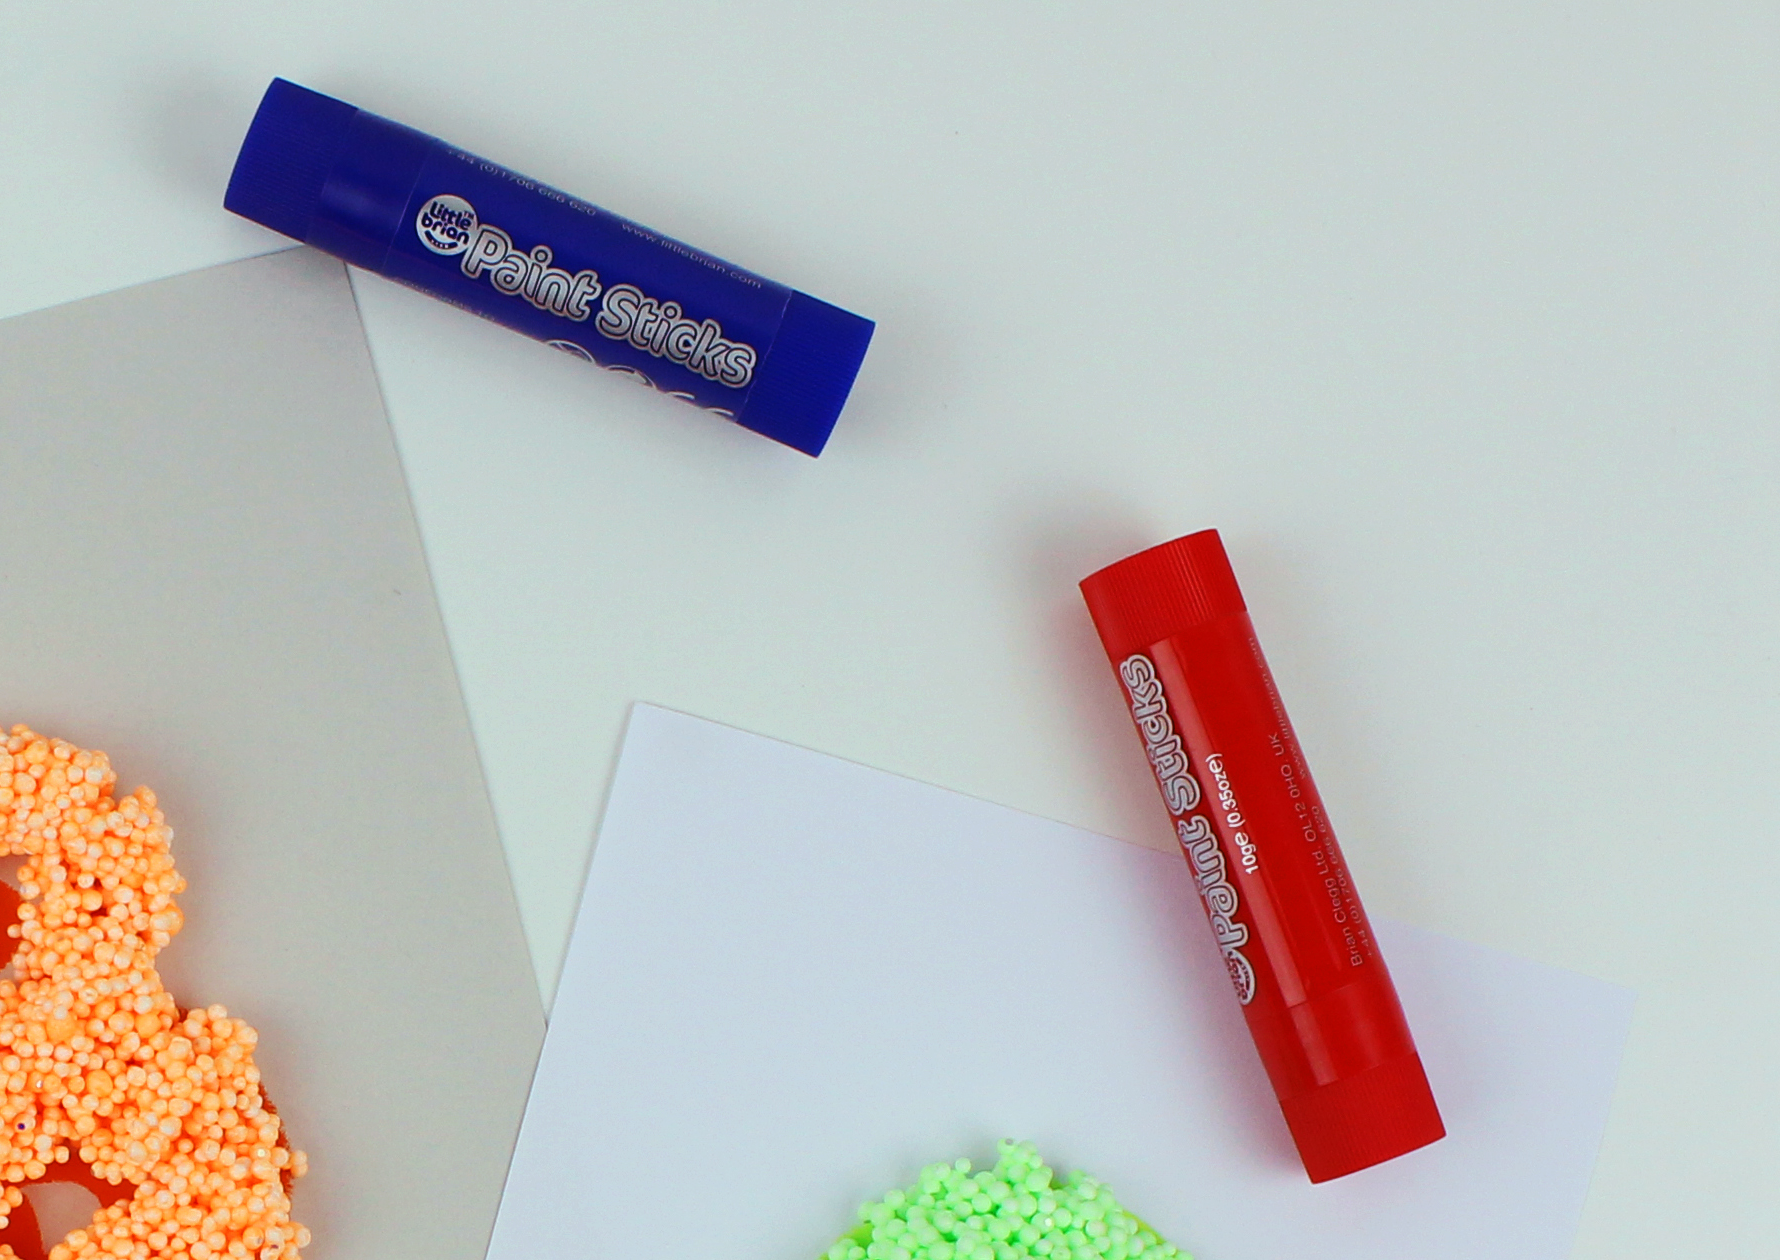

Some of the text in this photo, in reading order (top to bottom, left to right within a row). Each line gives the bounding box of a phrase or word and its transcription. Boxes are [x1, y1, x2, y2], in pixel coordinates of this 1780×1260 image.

[419, 212, 472, 244] brian
[428, 200, 473, 231] Little
[460, 222, 601, 321] Paint
[595, 283, 756, 387] Sticks
[1267, 731, 1285, 756] UK
[1119, 654, 1247, 954] Paint Sticks
[1292, 800, 1317, 842] OL12
[1321, 876, 1349, 923] Clegg
[1339, 926, 1363, 966] Brian
